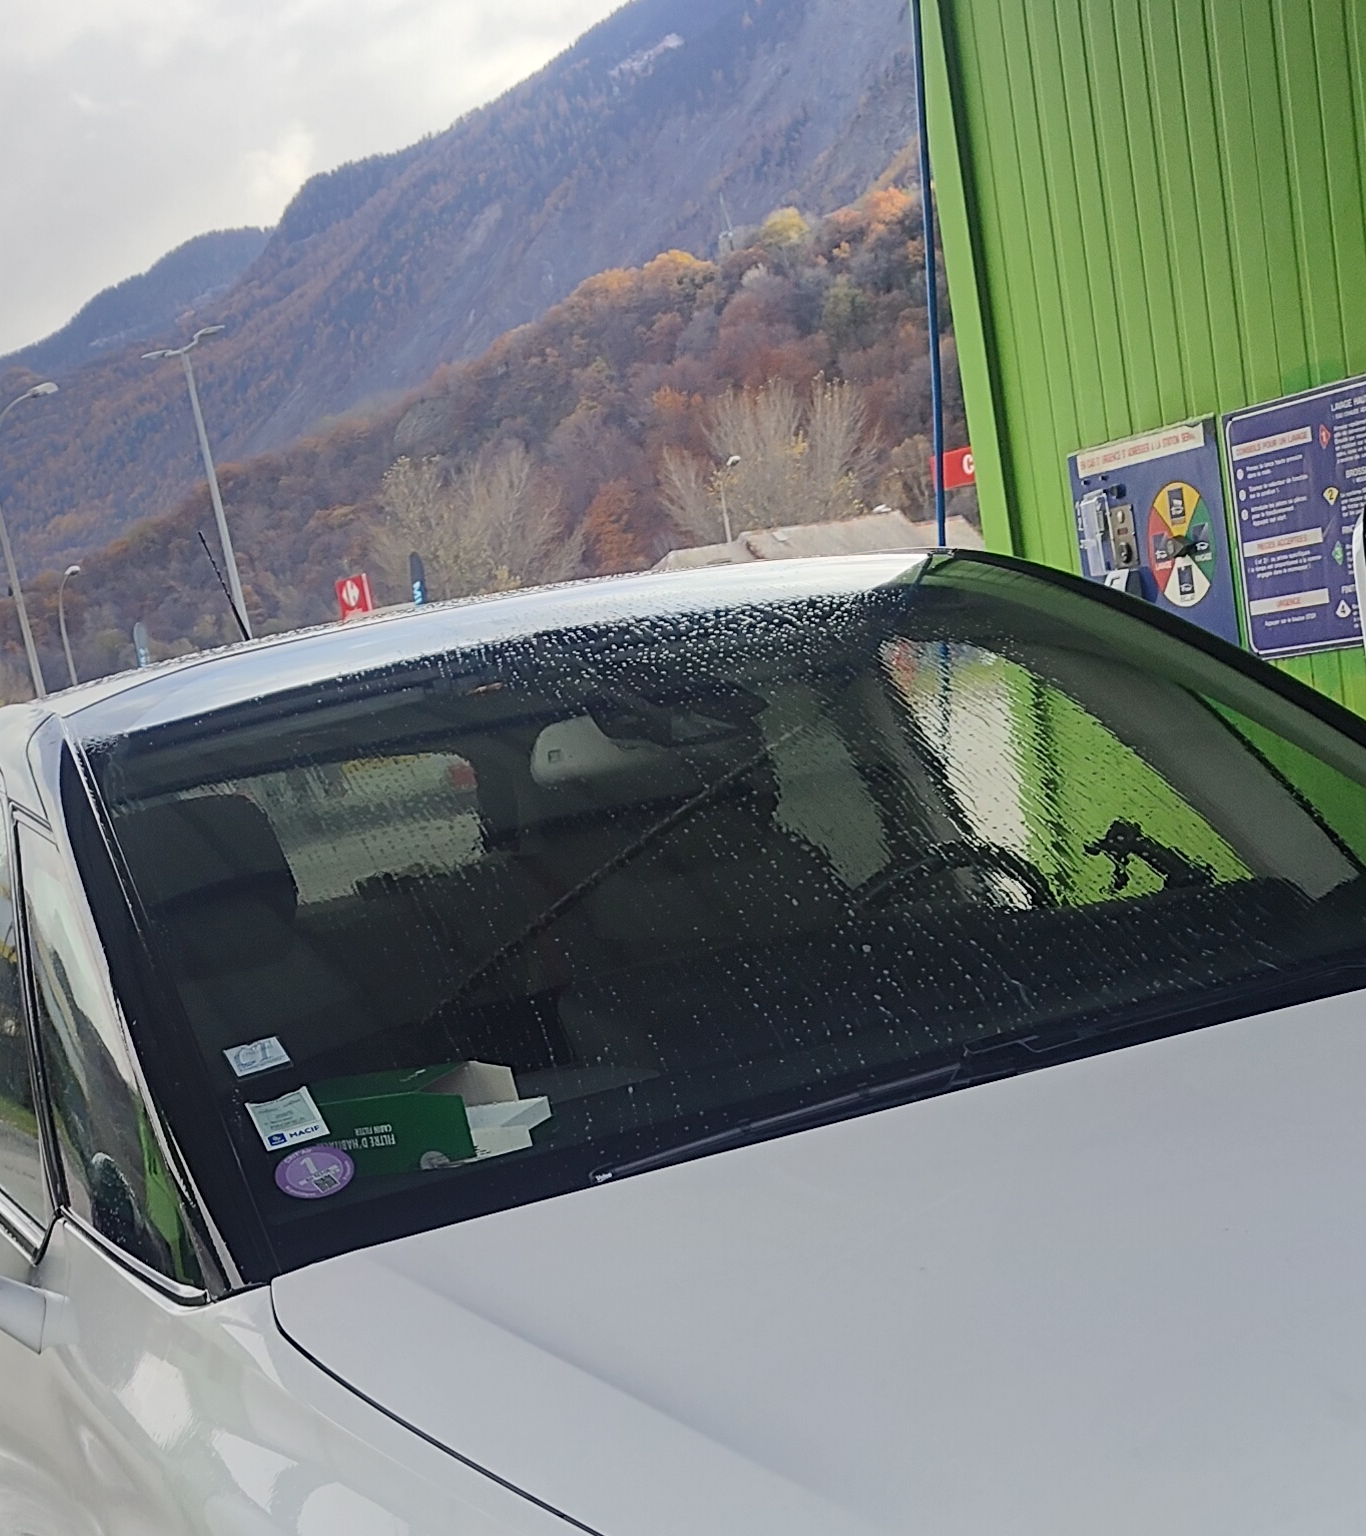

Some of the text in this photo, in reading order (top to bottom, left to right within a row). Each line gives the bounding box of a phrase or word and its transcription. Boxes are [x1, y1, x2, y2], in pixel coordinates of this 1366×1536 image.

[289, 1125, 320, 1138] MACIF
[370, 1133, 396, 1147] FILTRE
[300, 1157, 317, 1174] 1
